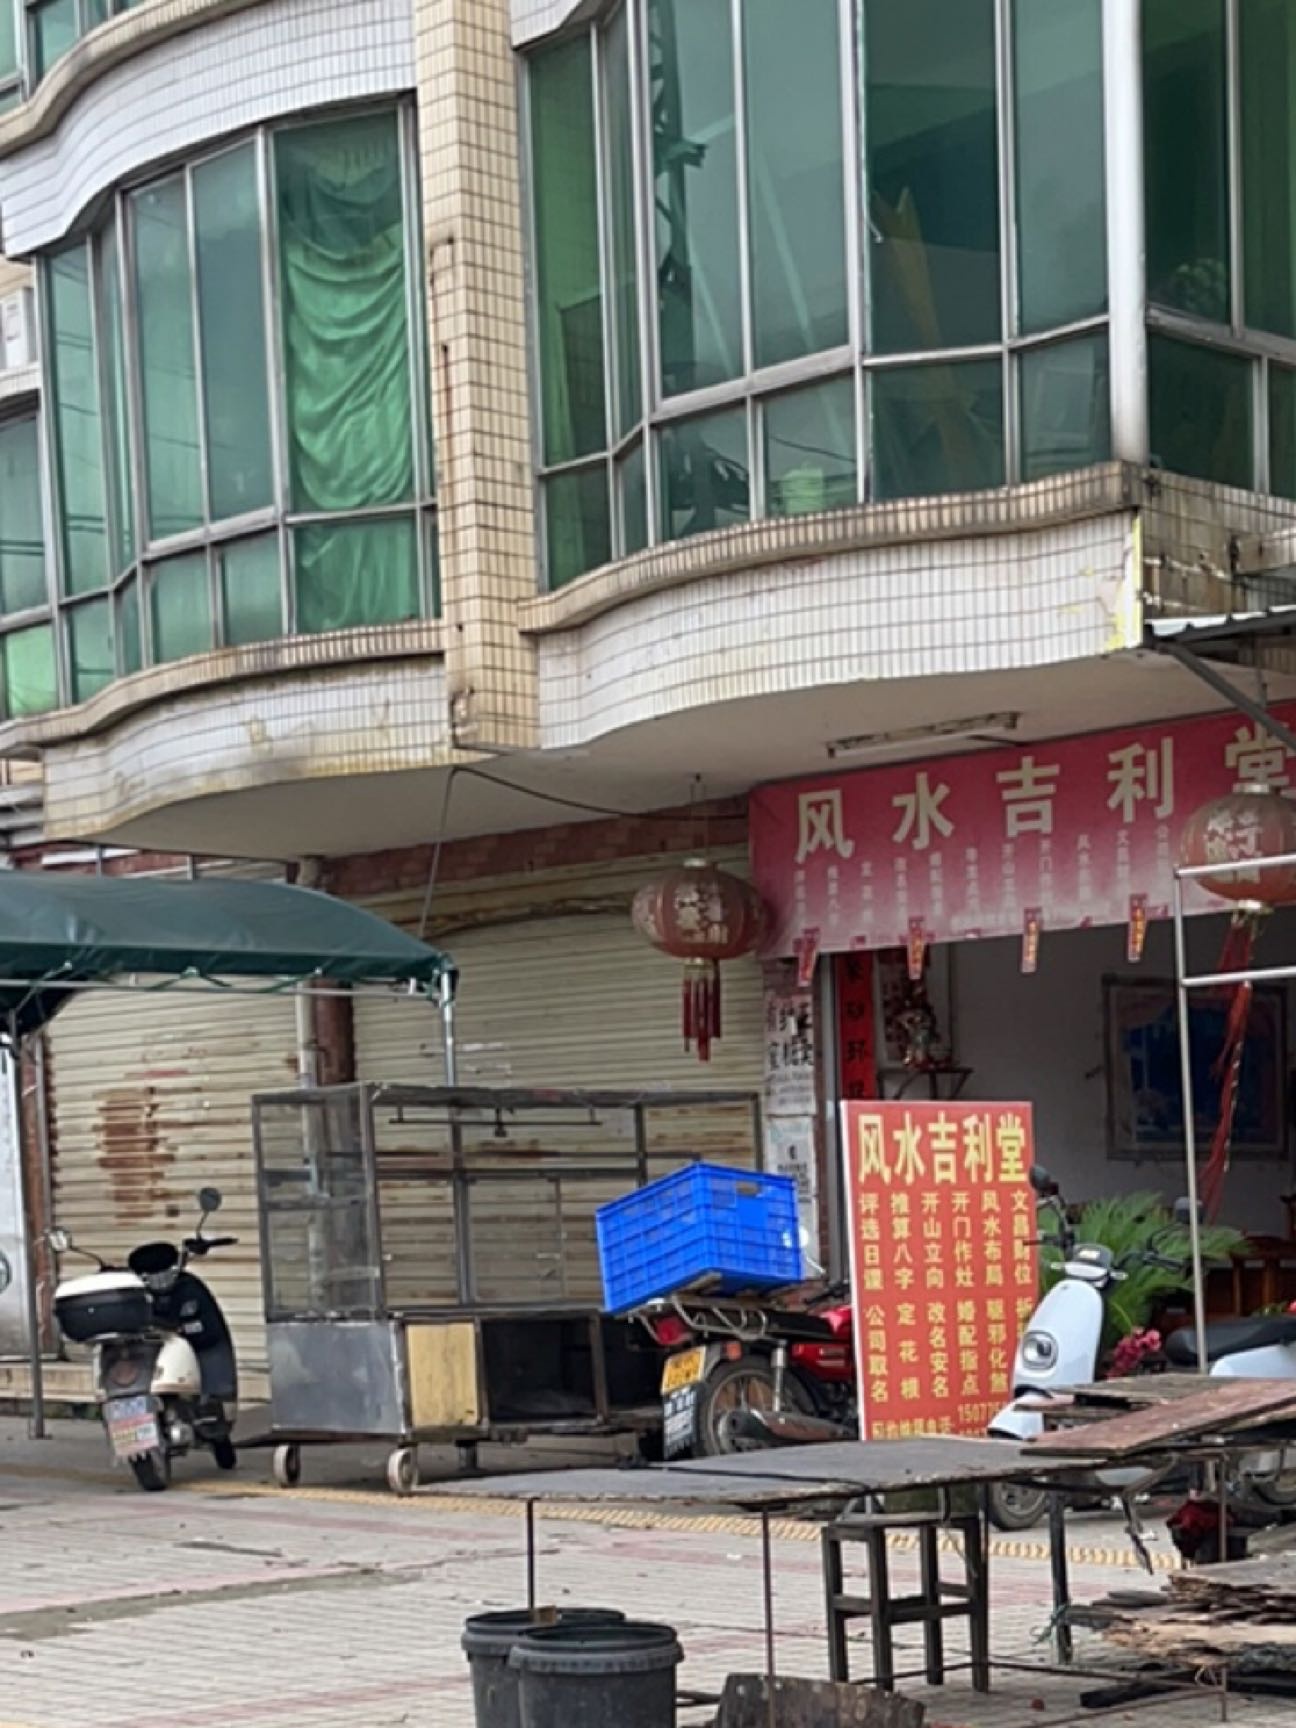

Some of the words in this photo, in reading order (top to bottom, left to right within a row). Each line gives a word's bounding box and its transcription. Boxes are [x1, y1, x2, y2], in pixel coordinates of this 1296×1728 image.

[857, 1110, 1028, 1186] 风水吉利堂
[921, 1192, 945, 1289] 开山立向
[980, 1190, 1003, 1287] 风水布局
[865, 1303, 888, 1403] 公司取名
